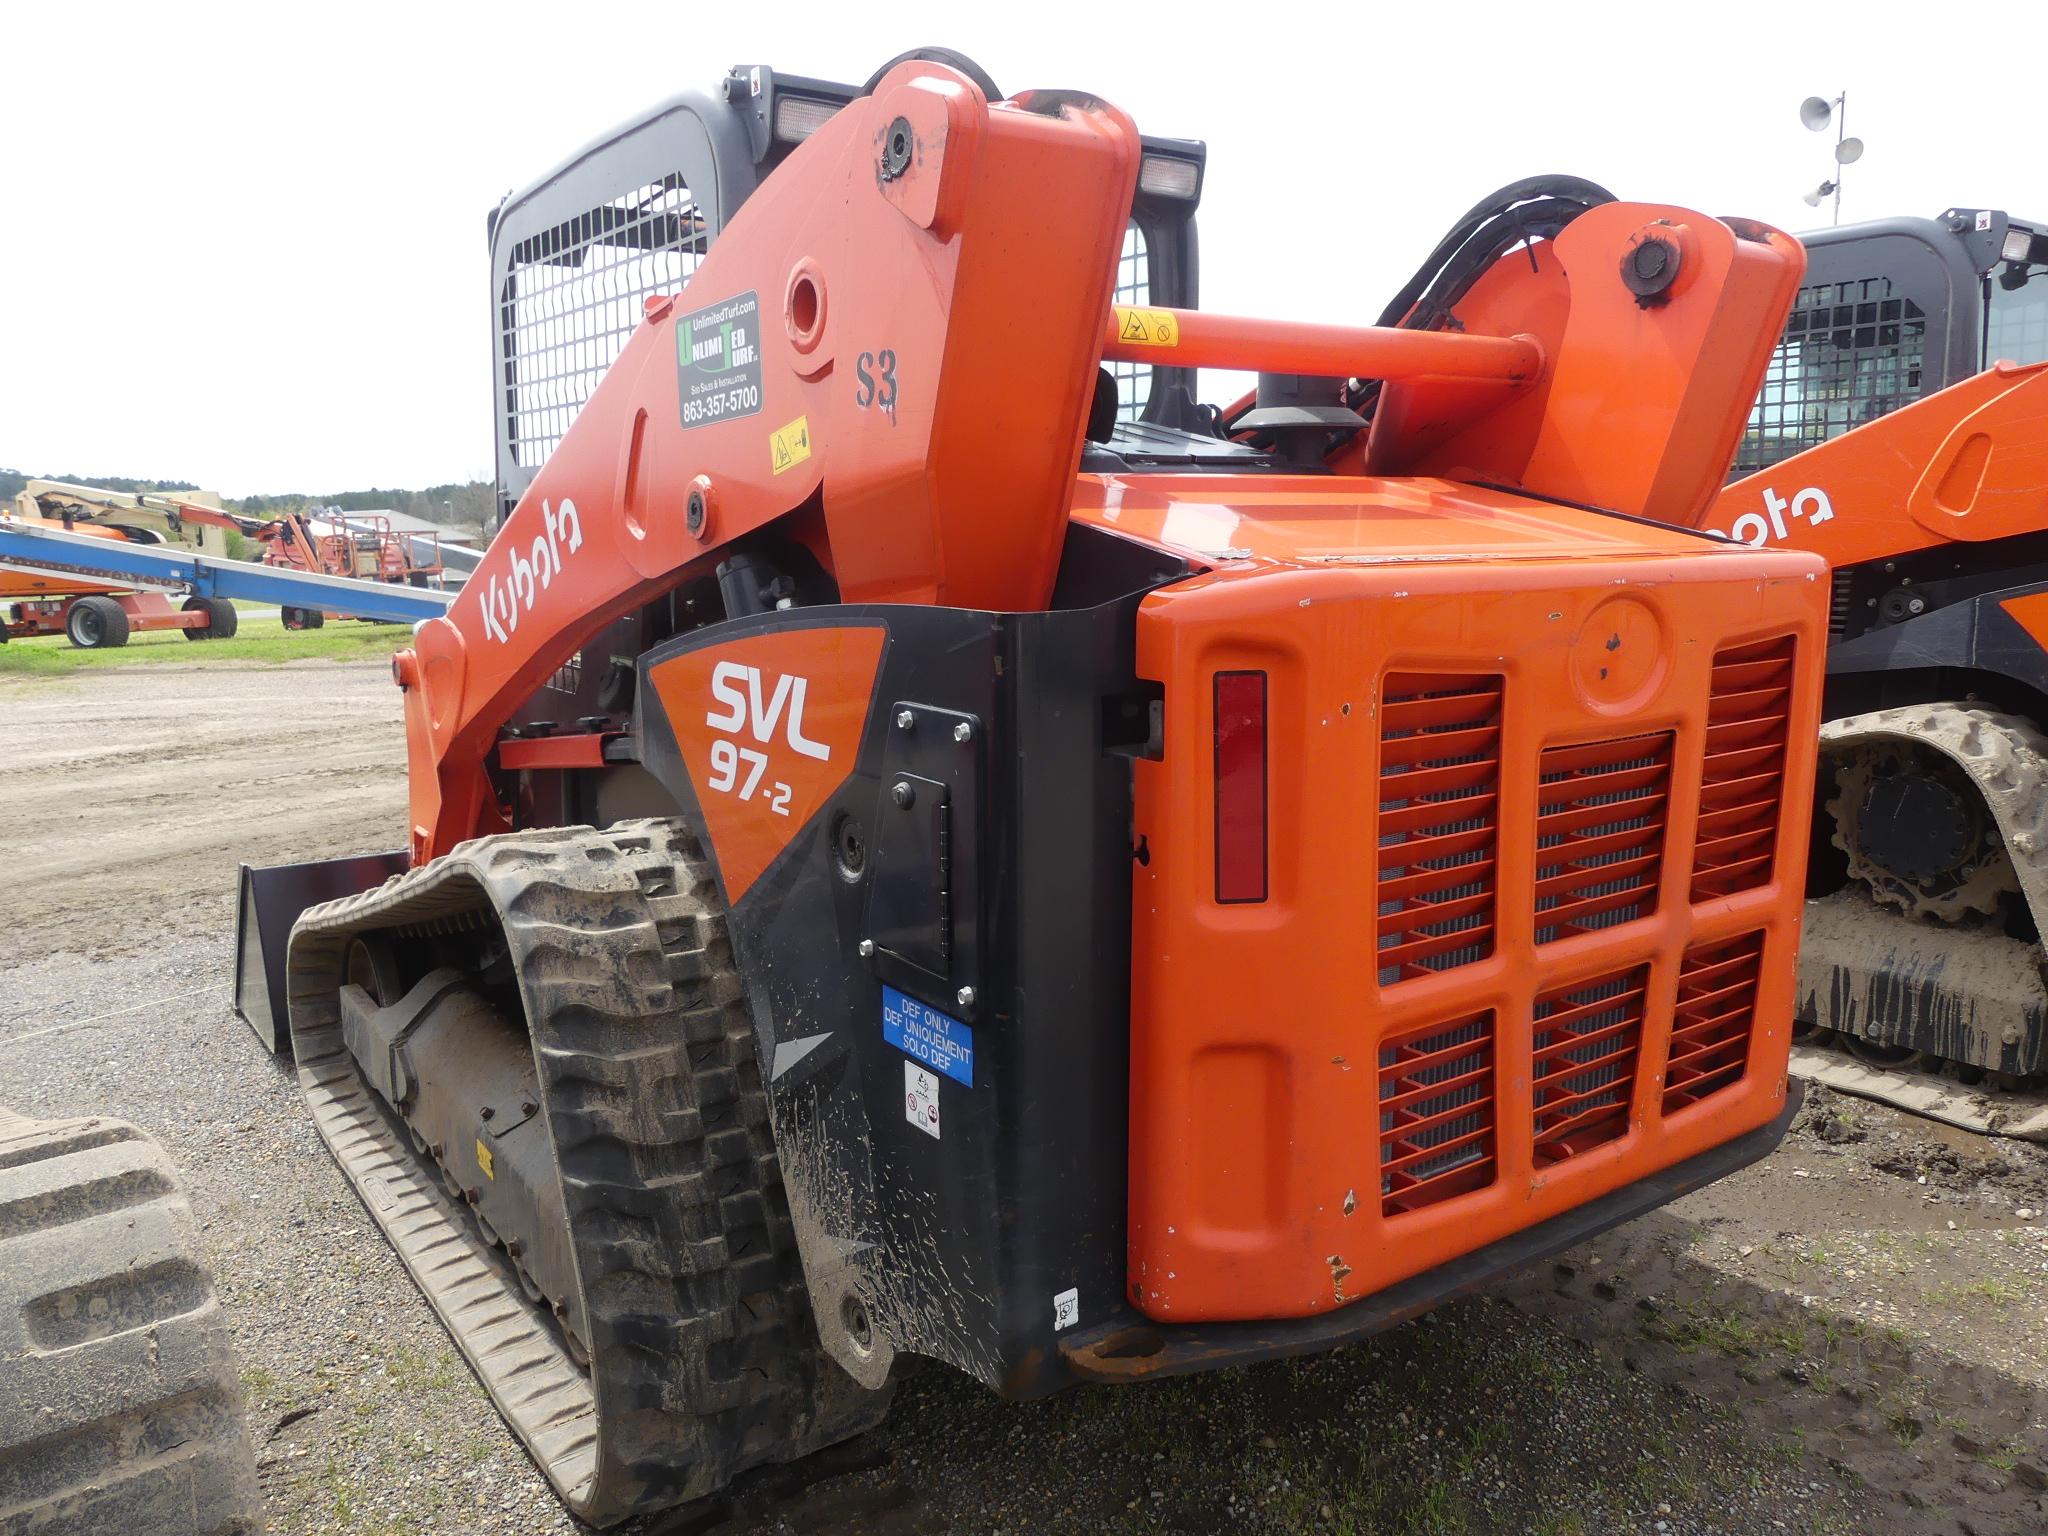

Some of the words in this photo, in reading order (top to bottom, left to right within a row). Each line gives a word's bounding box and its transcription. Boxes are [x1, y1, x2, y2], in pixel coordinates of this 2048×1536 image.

[693, 300, 756, 331] UnlimitedTurf.com
[683, 385, 758, 422] 863-357-5700
[856, 348, 898, 409] S3
[479, 498, 583, 644] Kubota
[706, 661, 831, 762] SVL
[709, 739, 792, 817] 97-2
[884, 1006, 902, 1027] DEF
[905, 1018, 970, 1064] UNIQUEMENT
[902, 998, 921, 1019] DEF
[924, 1010, 950, 1035] ONLY
[903, 1034, 928, 1059] SOLO
[931, 1048, 951, 1070] DEF
